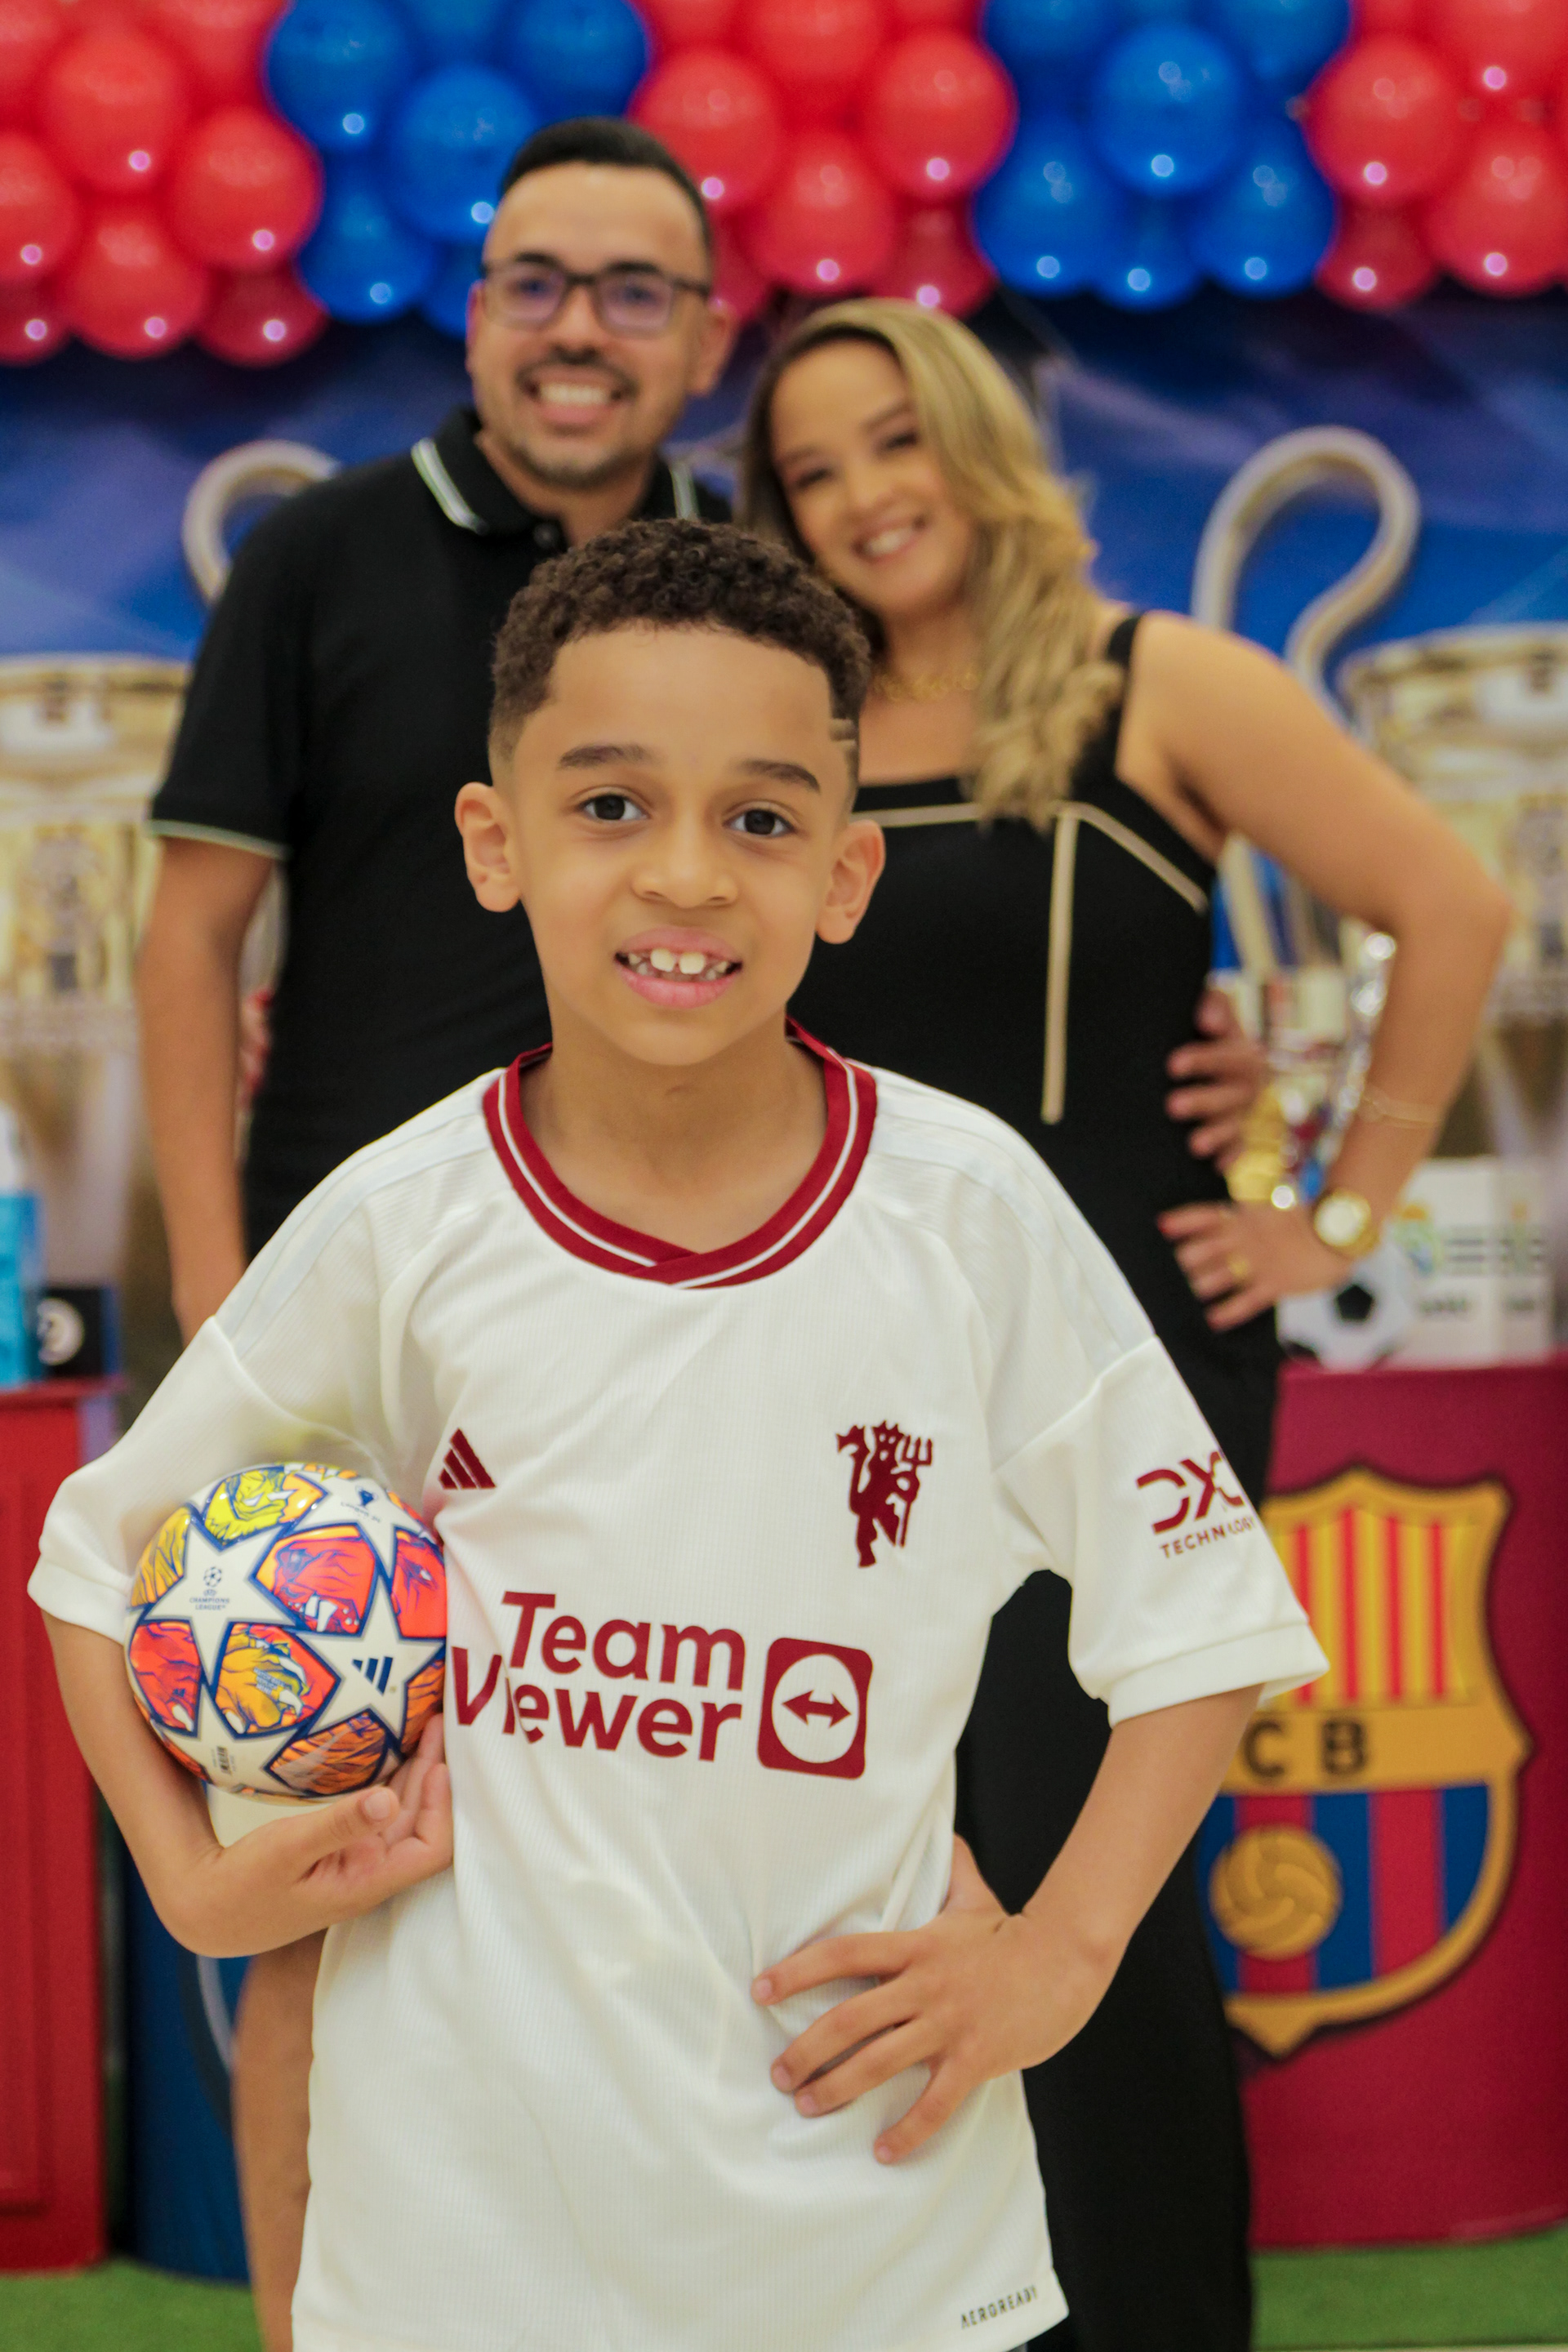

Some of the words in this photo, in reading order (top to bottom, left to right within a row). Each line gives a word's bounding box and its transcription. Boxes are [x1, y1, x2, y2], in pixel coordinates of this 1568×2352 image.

[1159, 1517, 1257, 1558] TECHNLOGY
[501, 1590, 746, 1691] Team
[960, 2285, 1038, 2329] AEROREADY
